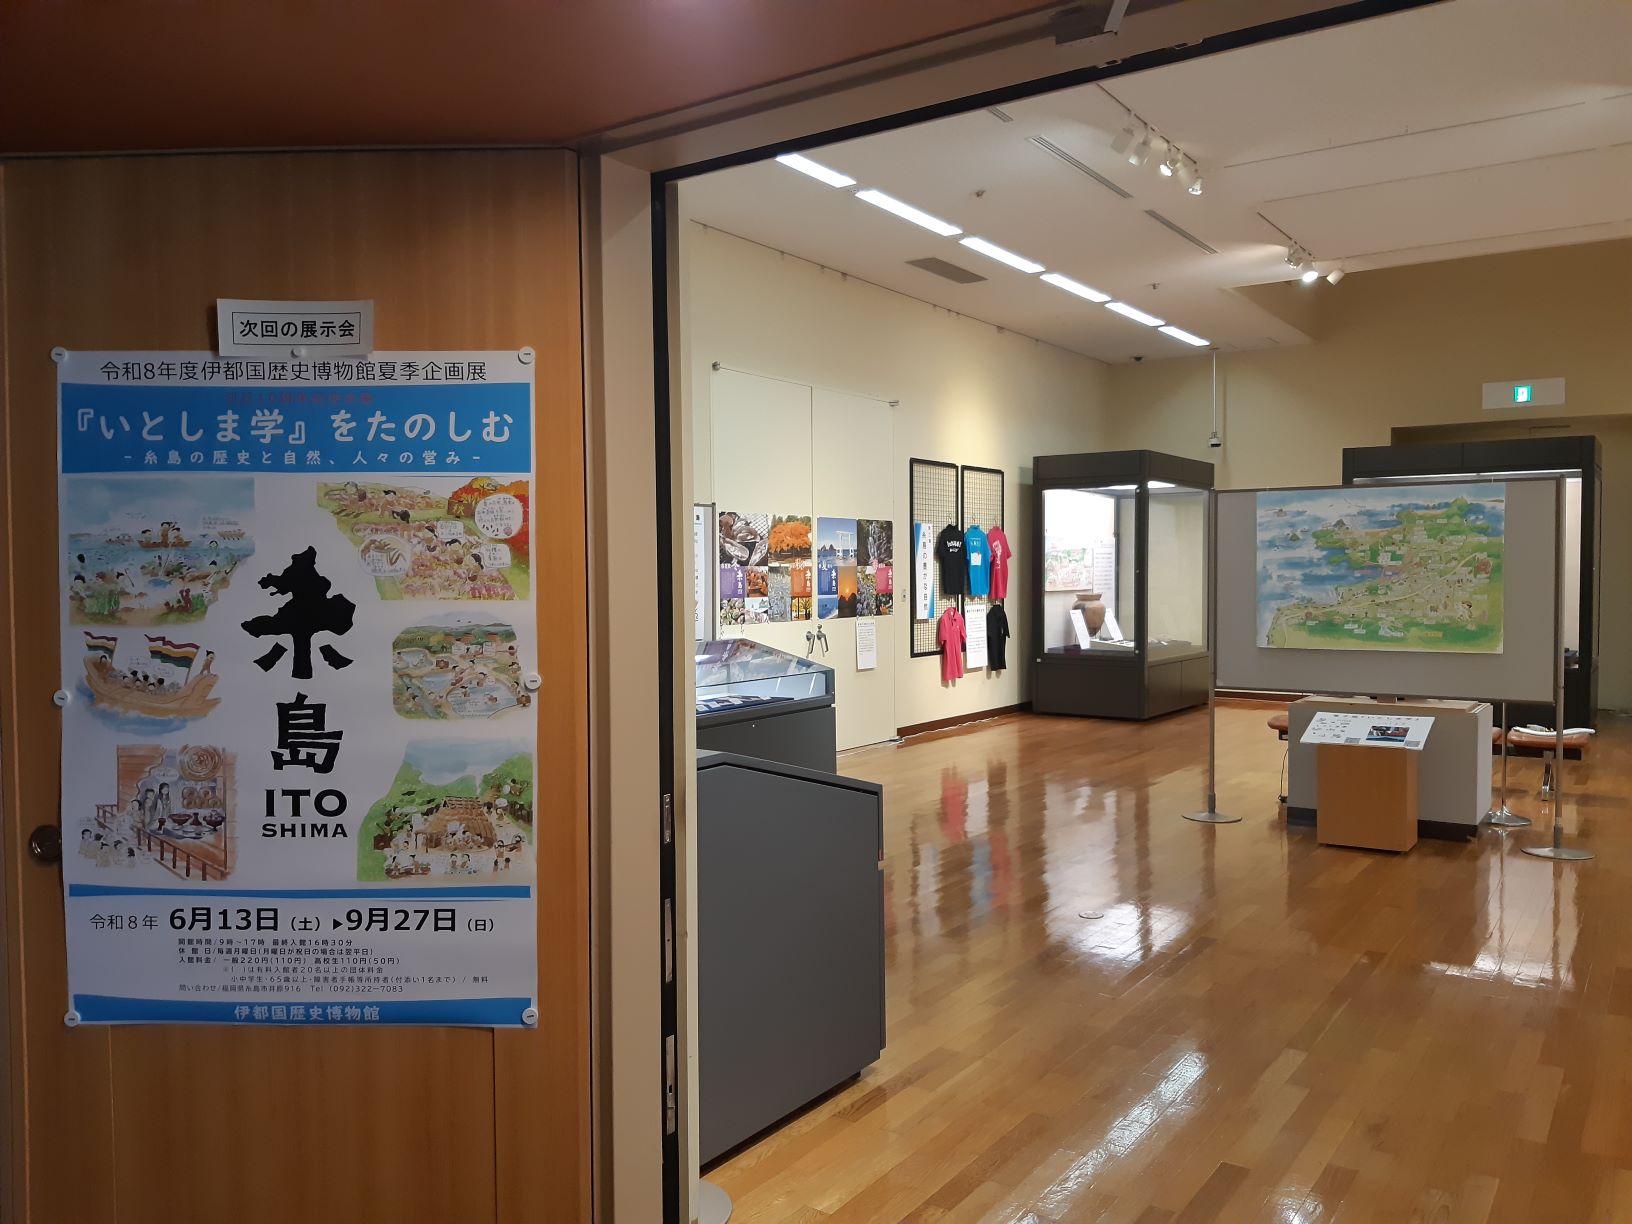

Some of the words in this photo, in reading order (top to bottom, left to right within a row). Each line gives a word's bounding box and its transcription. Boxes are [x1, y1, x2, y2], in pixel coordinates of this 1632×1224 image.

[239, 319, 355, 338] 次回の展示会
[100, 361, 487, 381] 令和8年度伊都国歴史博物館夏季企画展
[240, 545, 356, 774] 糸島
[264, 788, 348, 818] ITO
[261, 822, 349, 838] SHIMA
[89, 913, 160, 931] 令和8年
[169, 906, 279, 932] 6月13日
[345, 907, 456, 932] 9月27日
[234, 1004, 380, 1021] 伊都国歴史博物館
